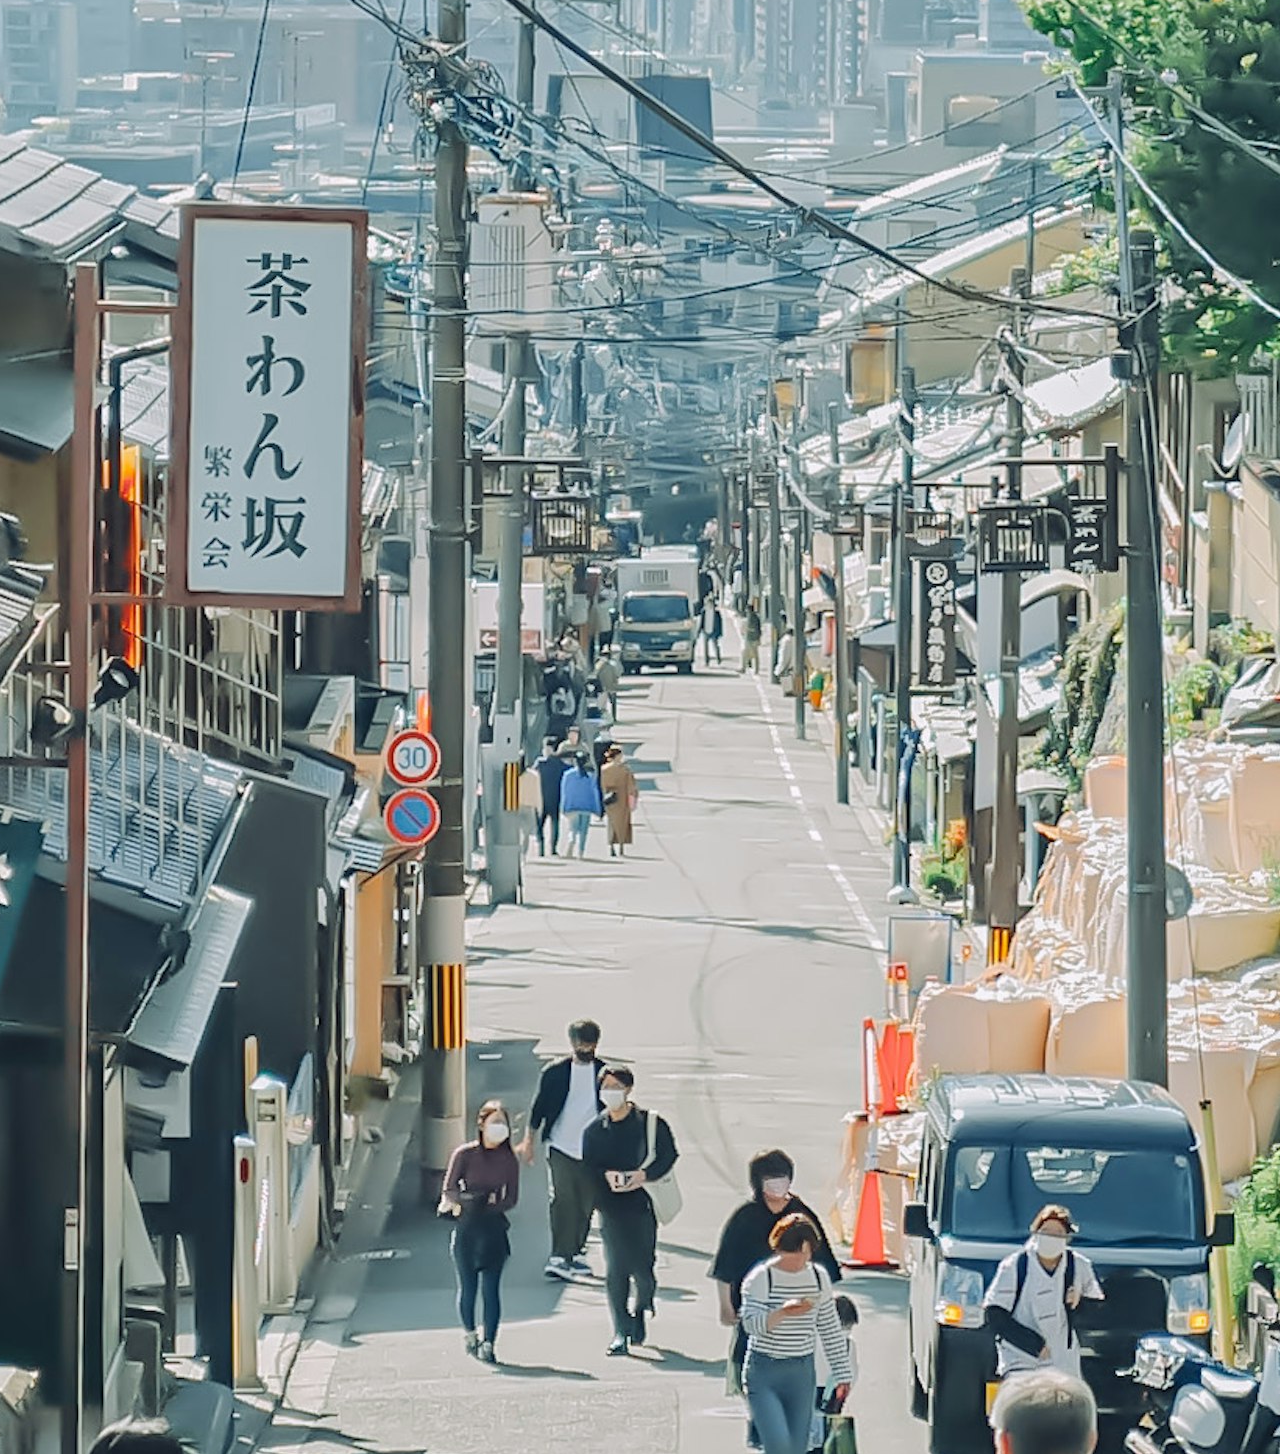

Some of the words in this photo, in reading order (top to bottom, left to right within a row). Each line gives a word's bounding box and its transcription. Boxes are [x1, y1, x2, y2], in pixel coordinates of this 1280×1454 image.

[241, 252, 312, 558] 茶わん坂
[200, 444, 233, 569] 繁栄会
[398, 747, 426, 769] 30
